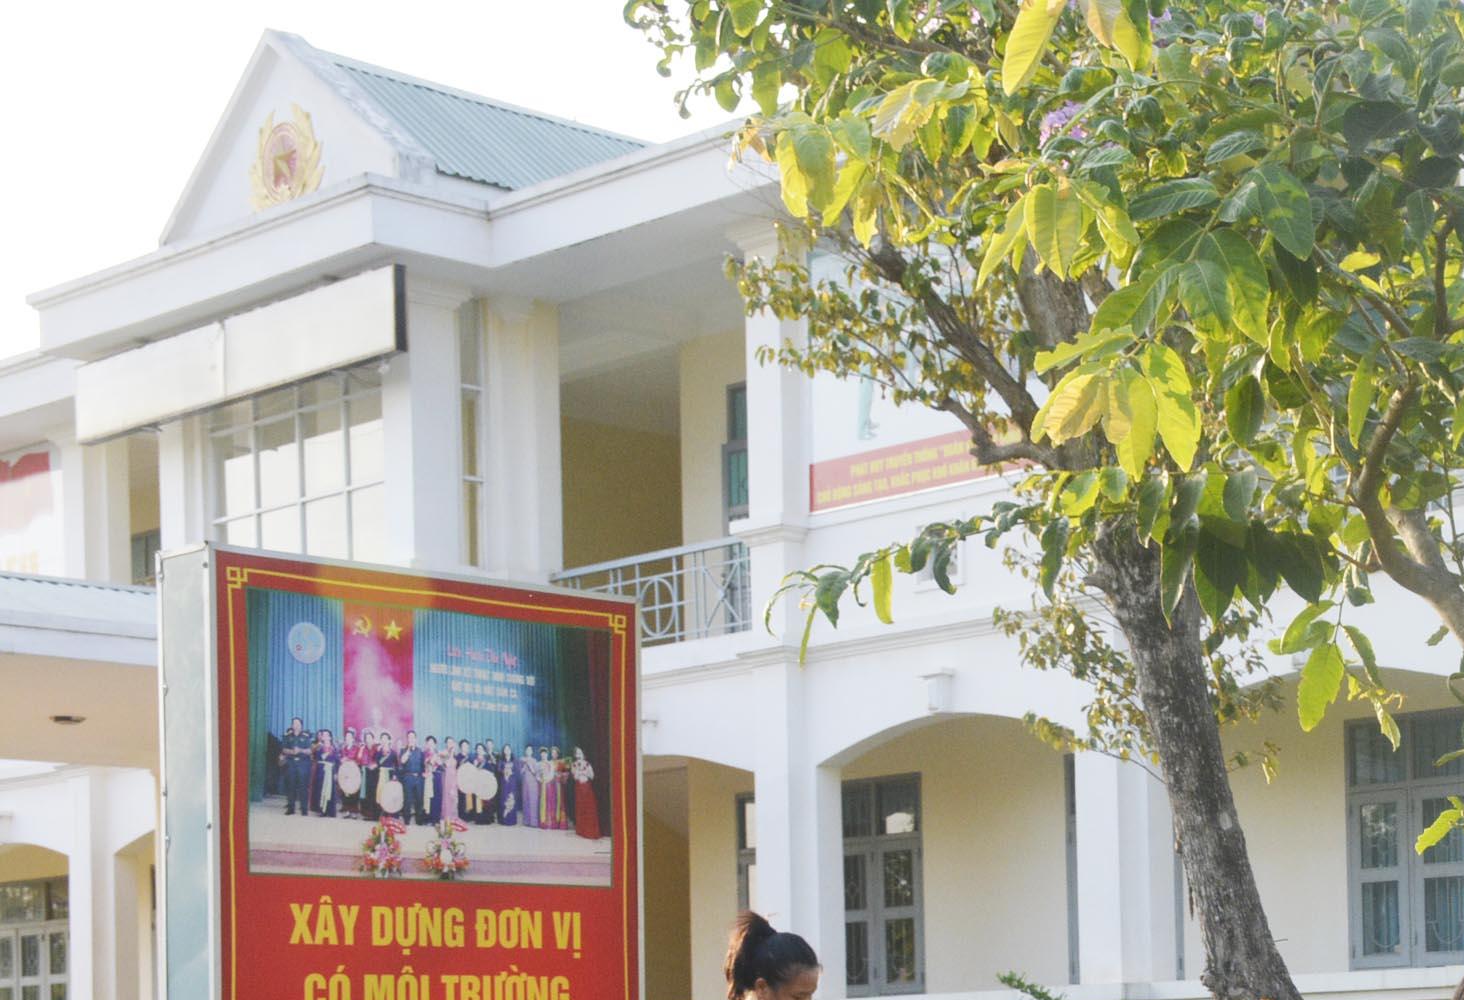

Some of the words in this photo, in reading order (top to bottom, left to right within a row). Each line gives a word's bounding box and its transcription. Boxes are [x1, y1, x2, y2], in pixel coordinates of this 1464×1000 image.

[290, 896, 359, 945] XÂY
[372, 903, 464, 955] DỰNG
[475, 907, 542, 948] ĐƠN
[553, 912, 581, 958] VỊ
